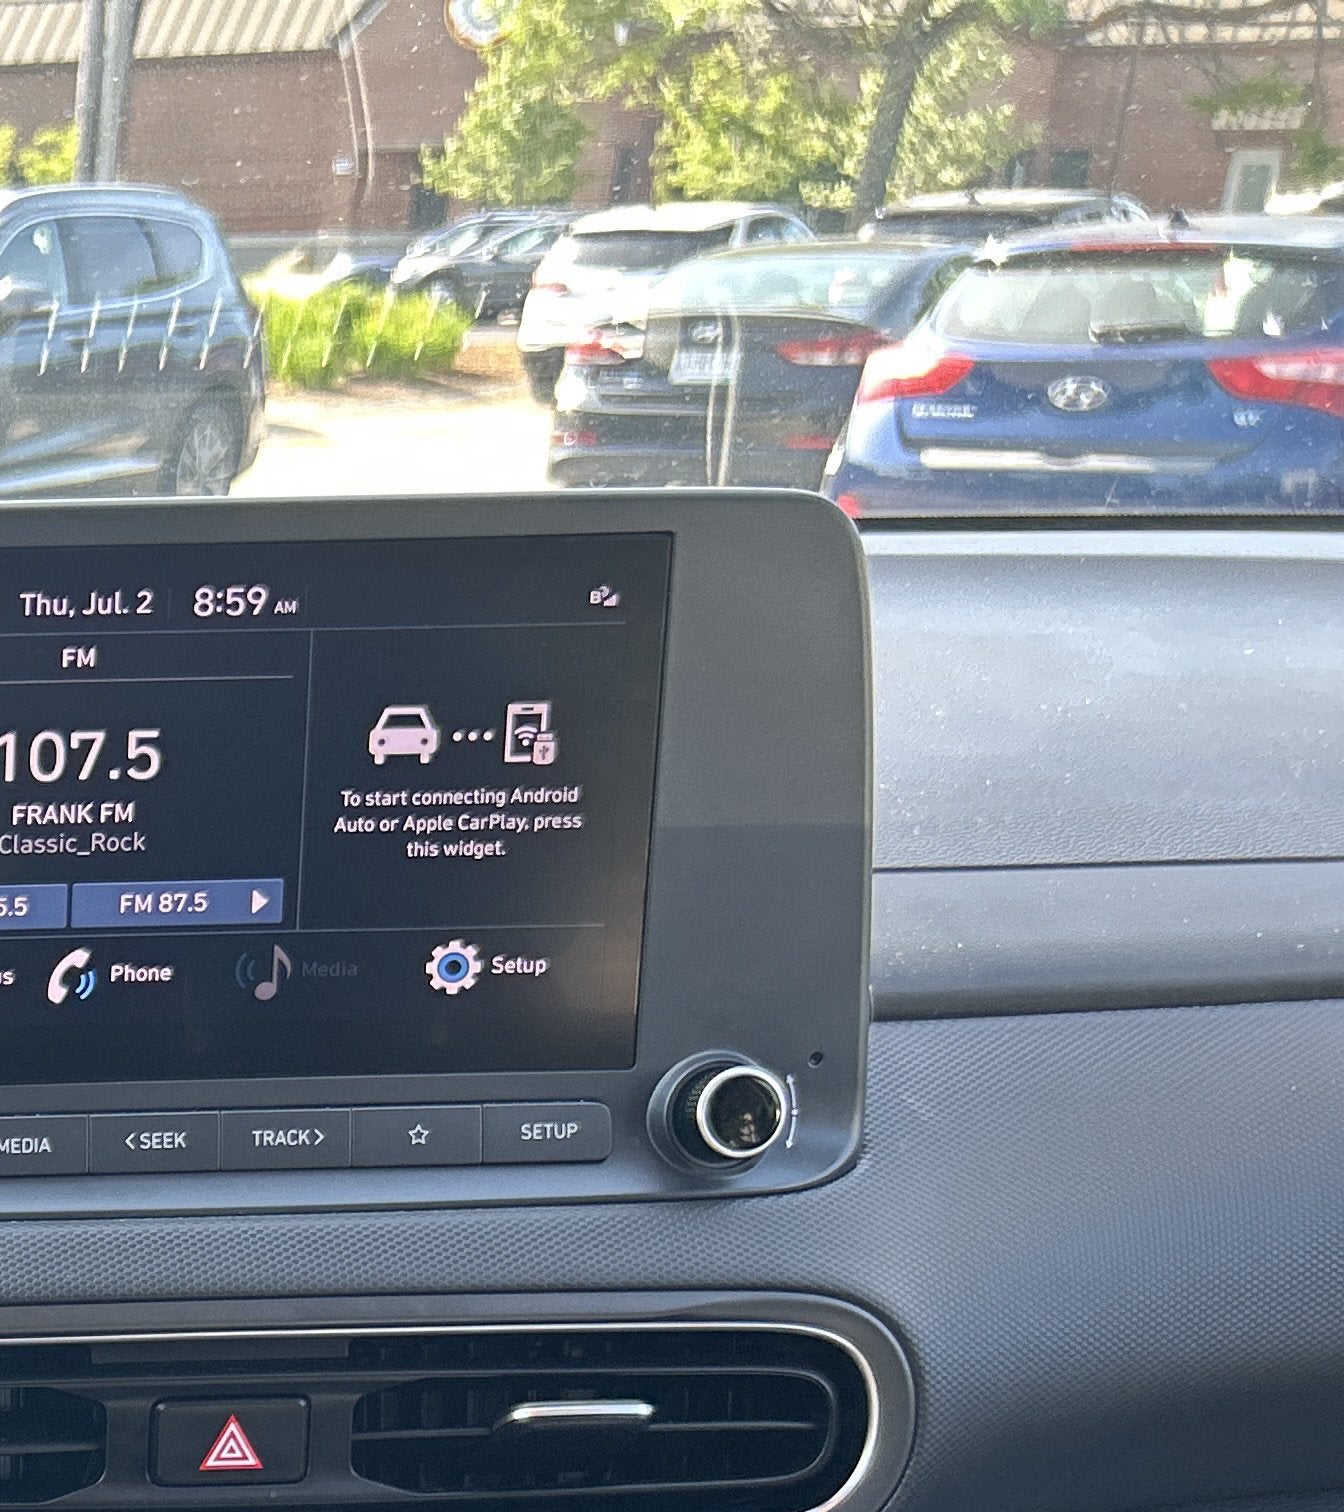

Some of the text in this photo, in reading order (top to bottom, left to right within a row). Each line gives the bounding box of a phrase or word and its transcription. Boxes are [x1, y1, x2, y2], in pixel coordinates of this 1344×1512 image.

[19, 589, 155, 618] Thu, Jul. 2
[193, 585, 299, 617] 8:59 AM
[61, 647, 96, 668] FM
[340, 786, 580, 808] To start connecting Android
[12, 801, 134, 825] FRANK FM
[333, 816, 375, 833] Auto
[379, 819, 399, 833] or
[402, 815, 454, 834] Apple
[533, 816, 583, 832] press
[406, 839, 507, 860] this widget.
[119, 892, 209, 914] FM 87.5
[110, 964, 173, 983] Phone
[301, 960, 359, 978] Media
[490, 955, 548, 977] Setup
[520, 1122, 578, 1141] SETUP
